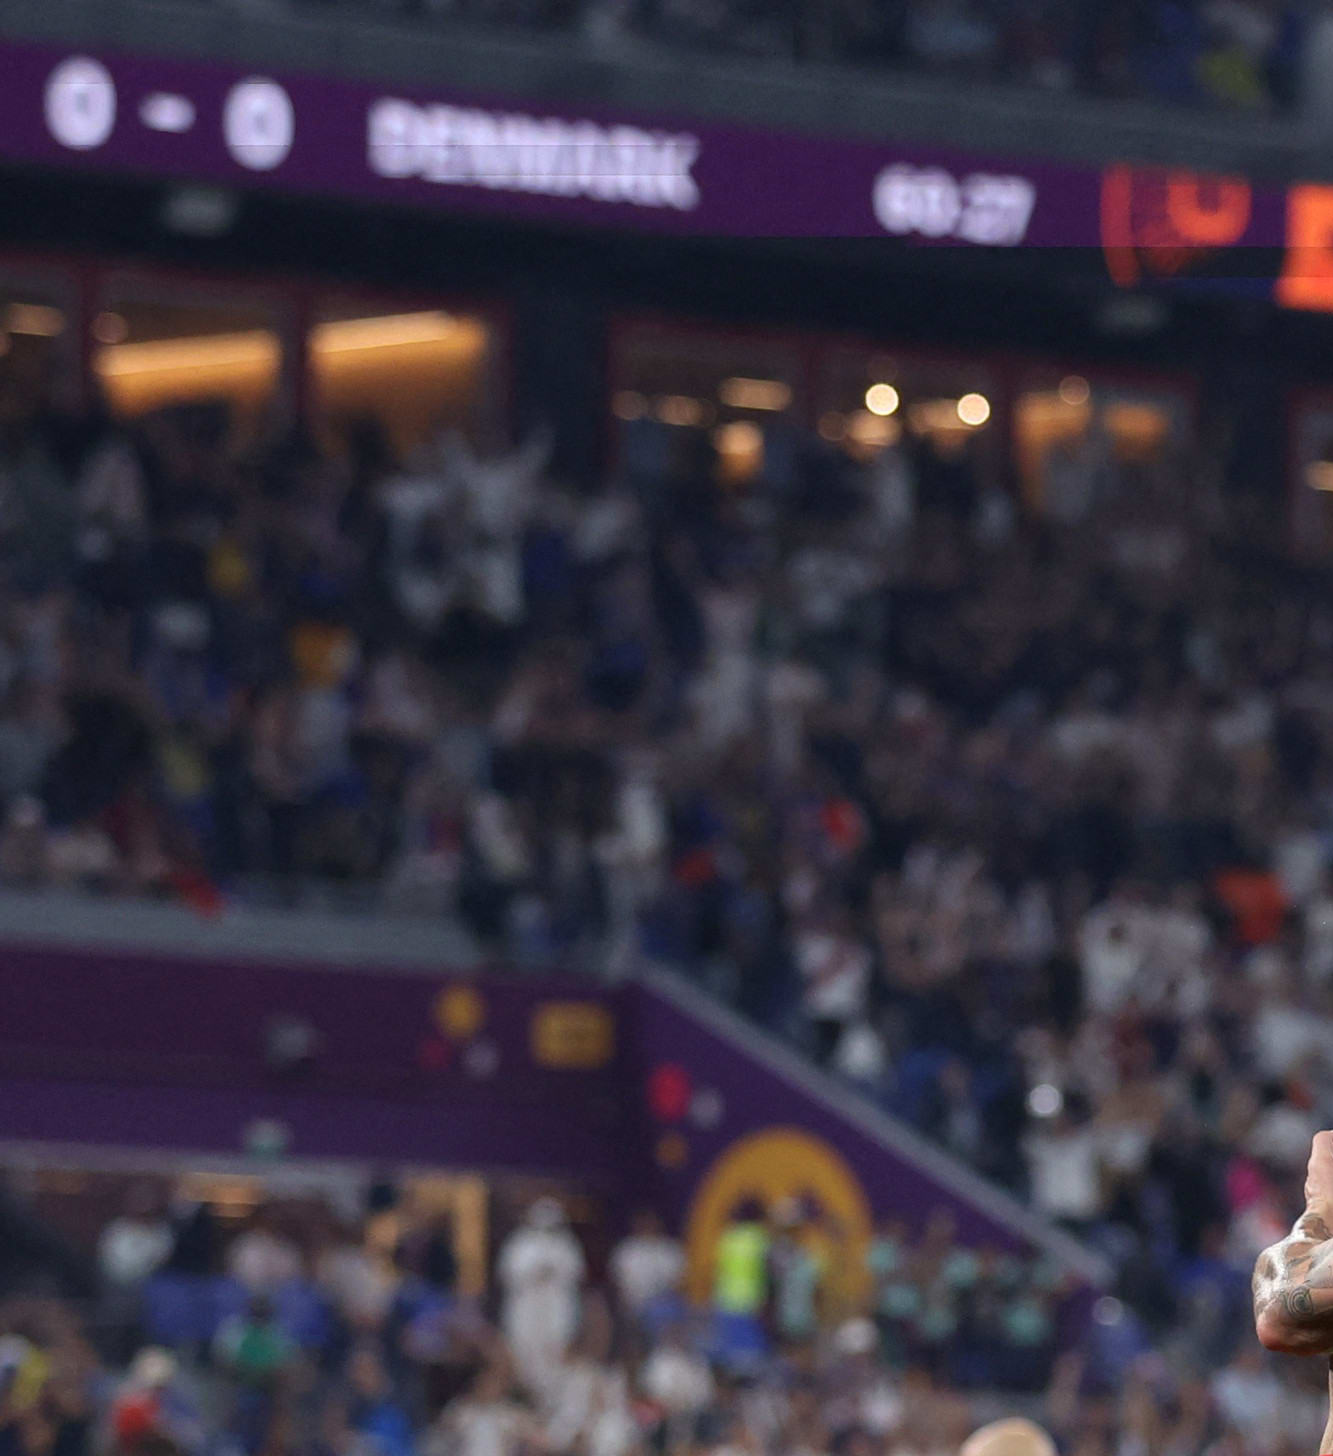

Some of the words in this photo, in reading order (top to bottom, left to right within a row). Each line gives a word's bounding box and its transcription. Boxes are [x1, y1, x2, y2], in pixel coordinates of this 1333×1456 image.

[45, 55, 117, 151] 0
[223, 76, 295, 172] 0
[367, 97, 700, 211] DENMARK
